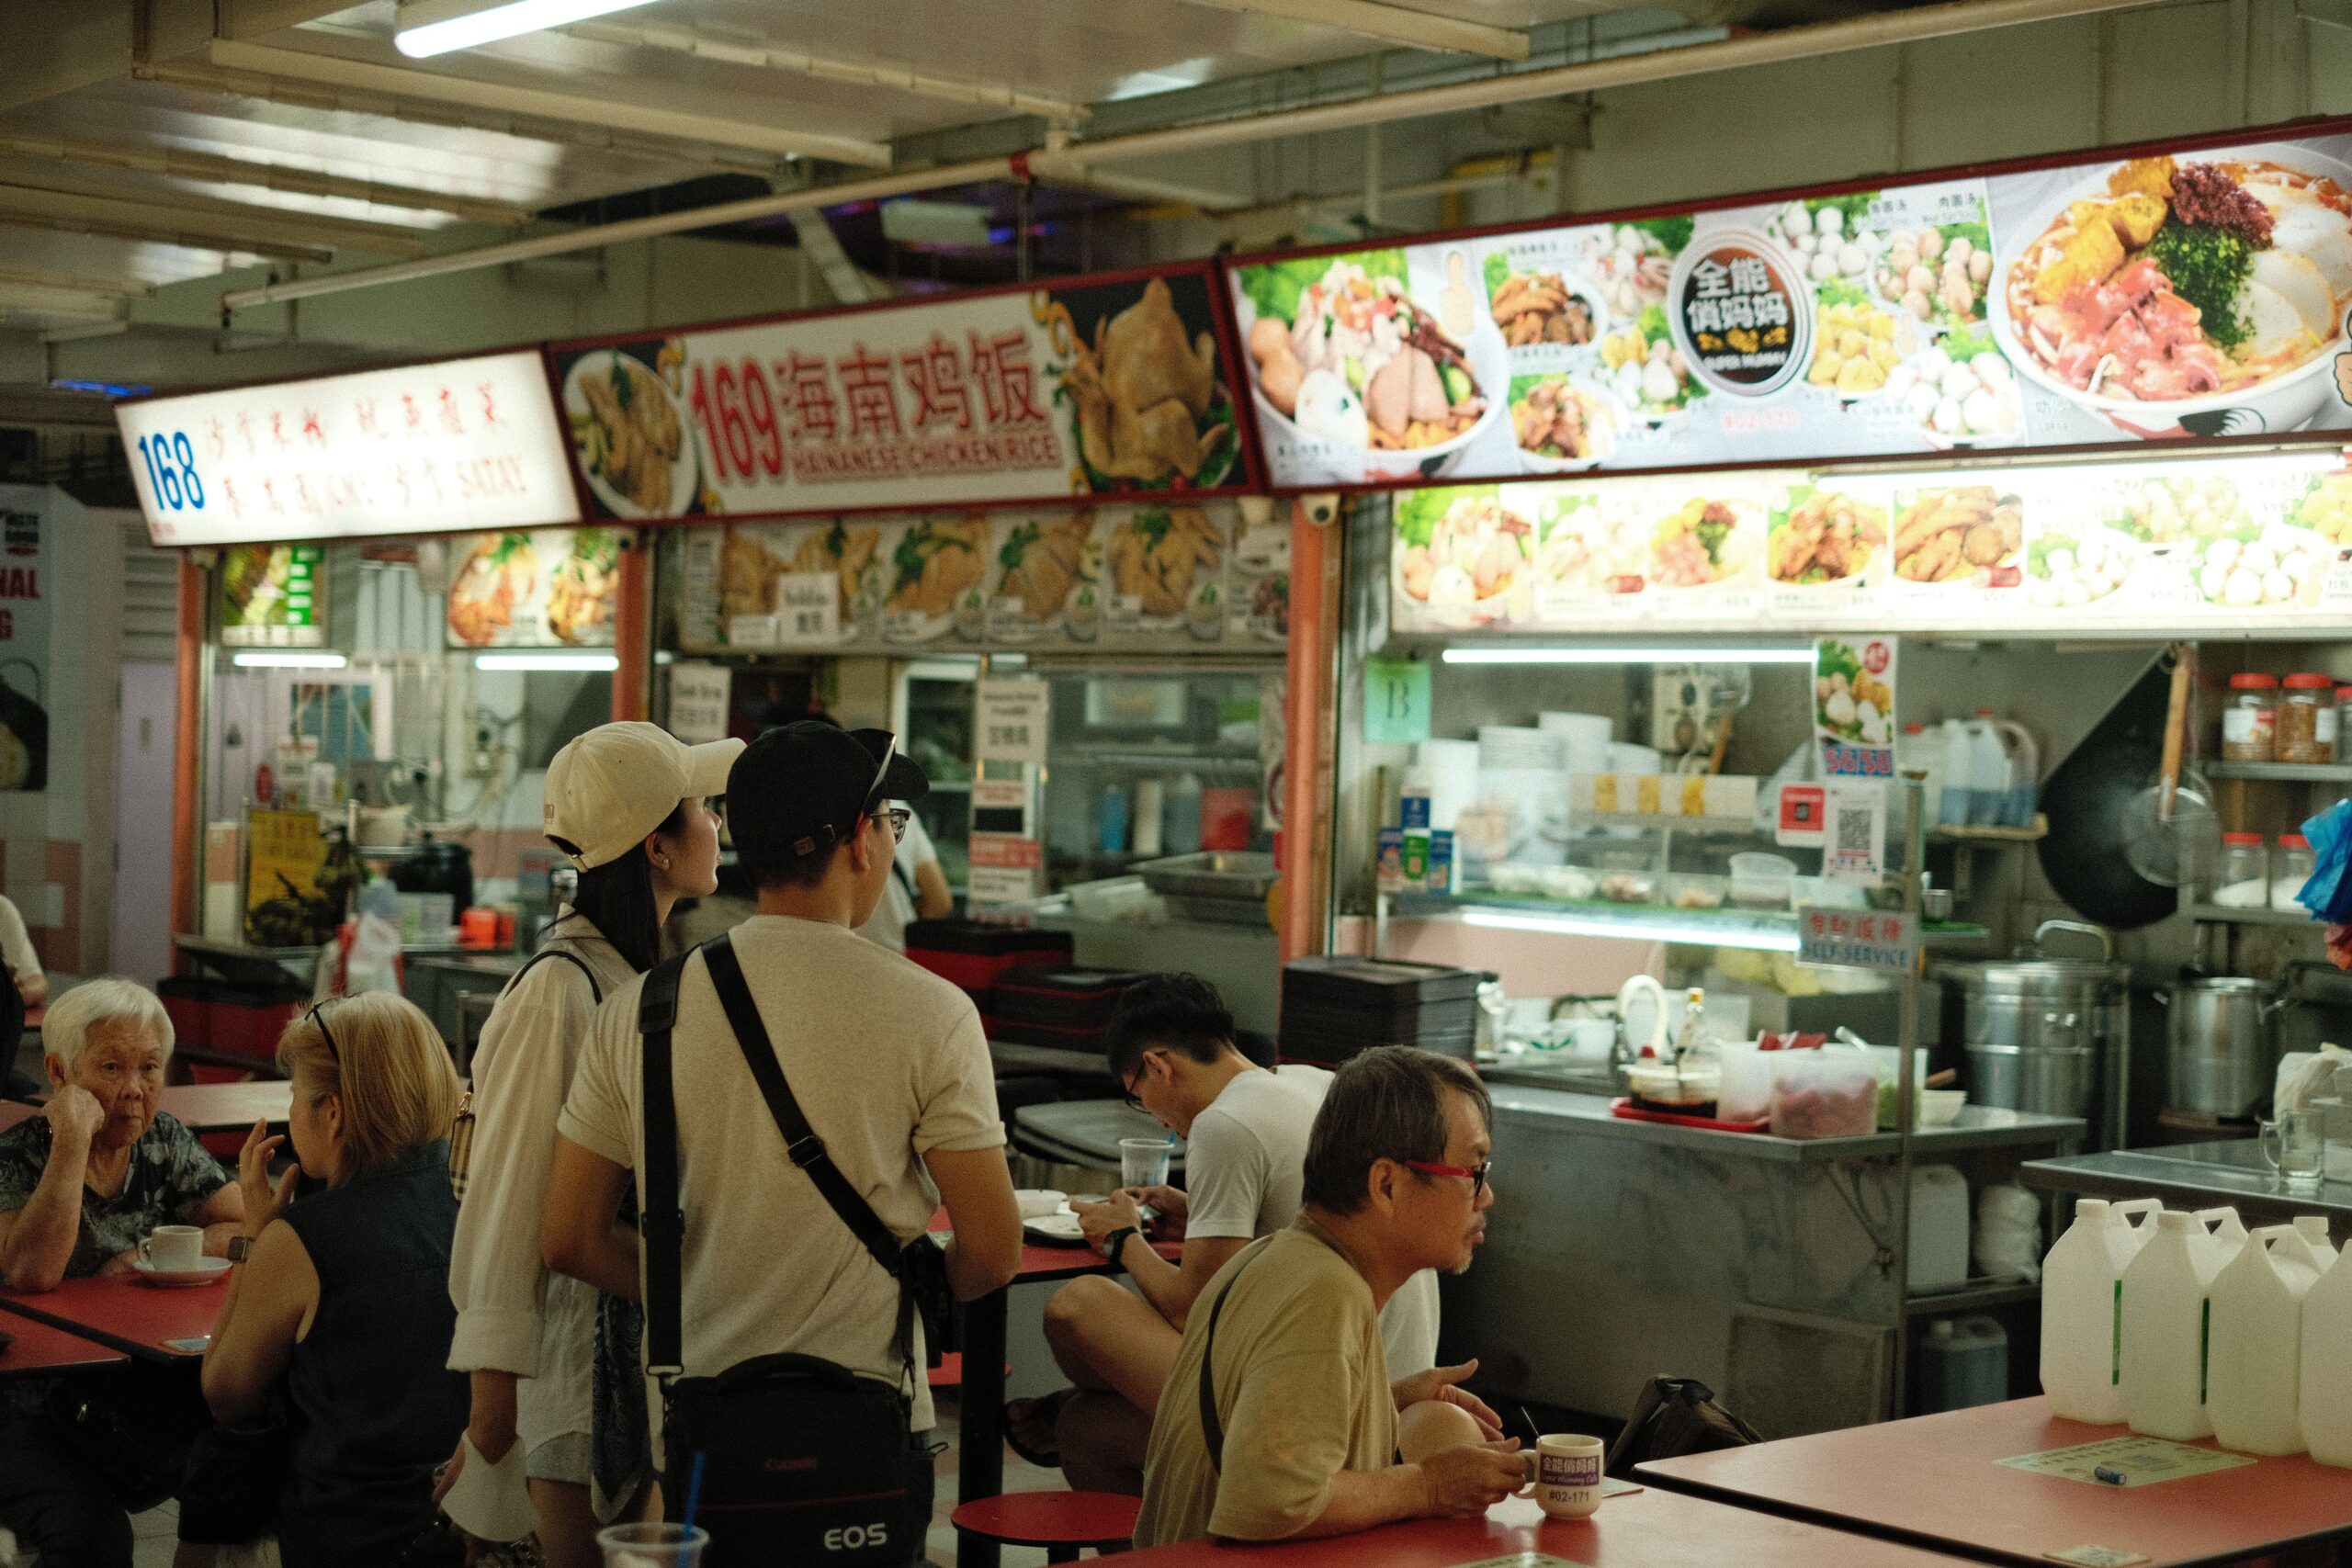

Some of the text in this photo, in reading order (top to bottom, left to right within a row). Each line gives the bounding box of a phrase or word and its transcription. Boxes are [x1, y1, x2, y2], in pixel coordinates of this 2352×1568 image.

[1691, 256, 1770, 299] 全能
[1741, 350, 1788, 367] MUMMY
[775, 328, 1046, 440] 海南鸡饭
[691, 359, 783, 478] 169
[139, 431, 205, 512] 168
[794, 426, 1060, 479] HAINANESE CHICKEN RICE
[1544, 1456, 1597, 1474] 全能俏妈妈
[1549, 1489, 1590, 1503] #02-171
[823, 1521, 888, 1551] EOS
